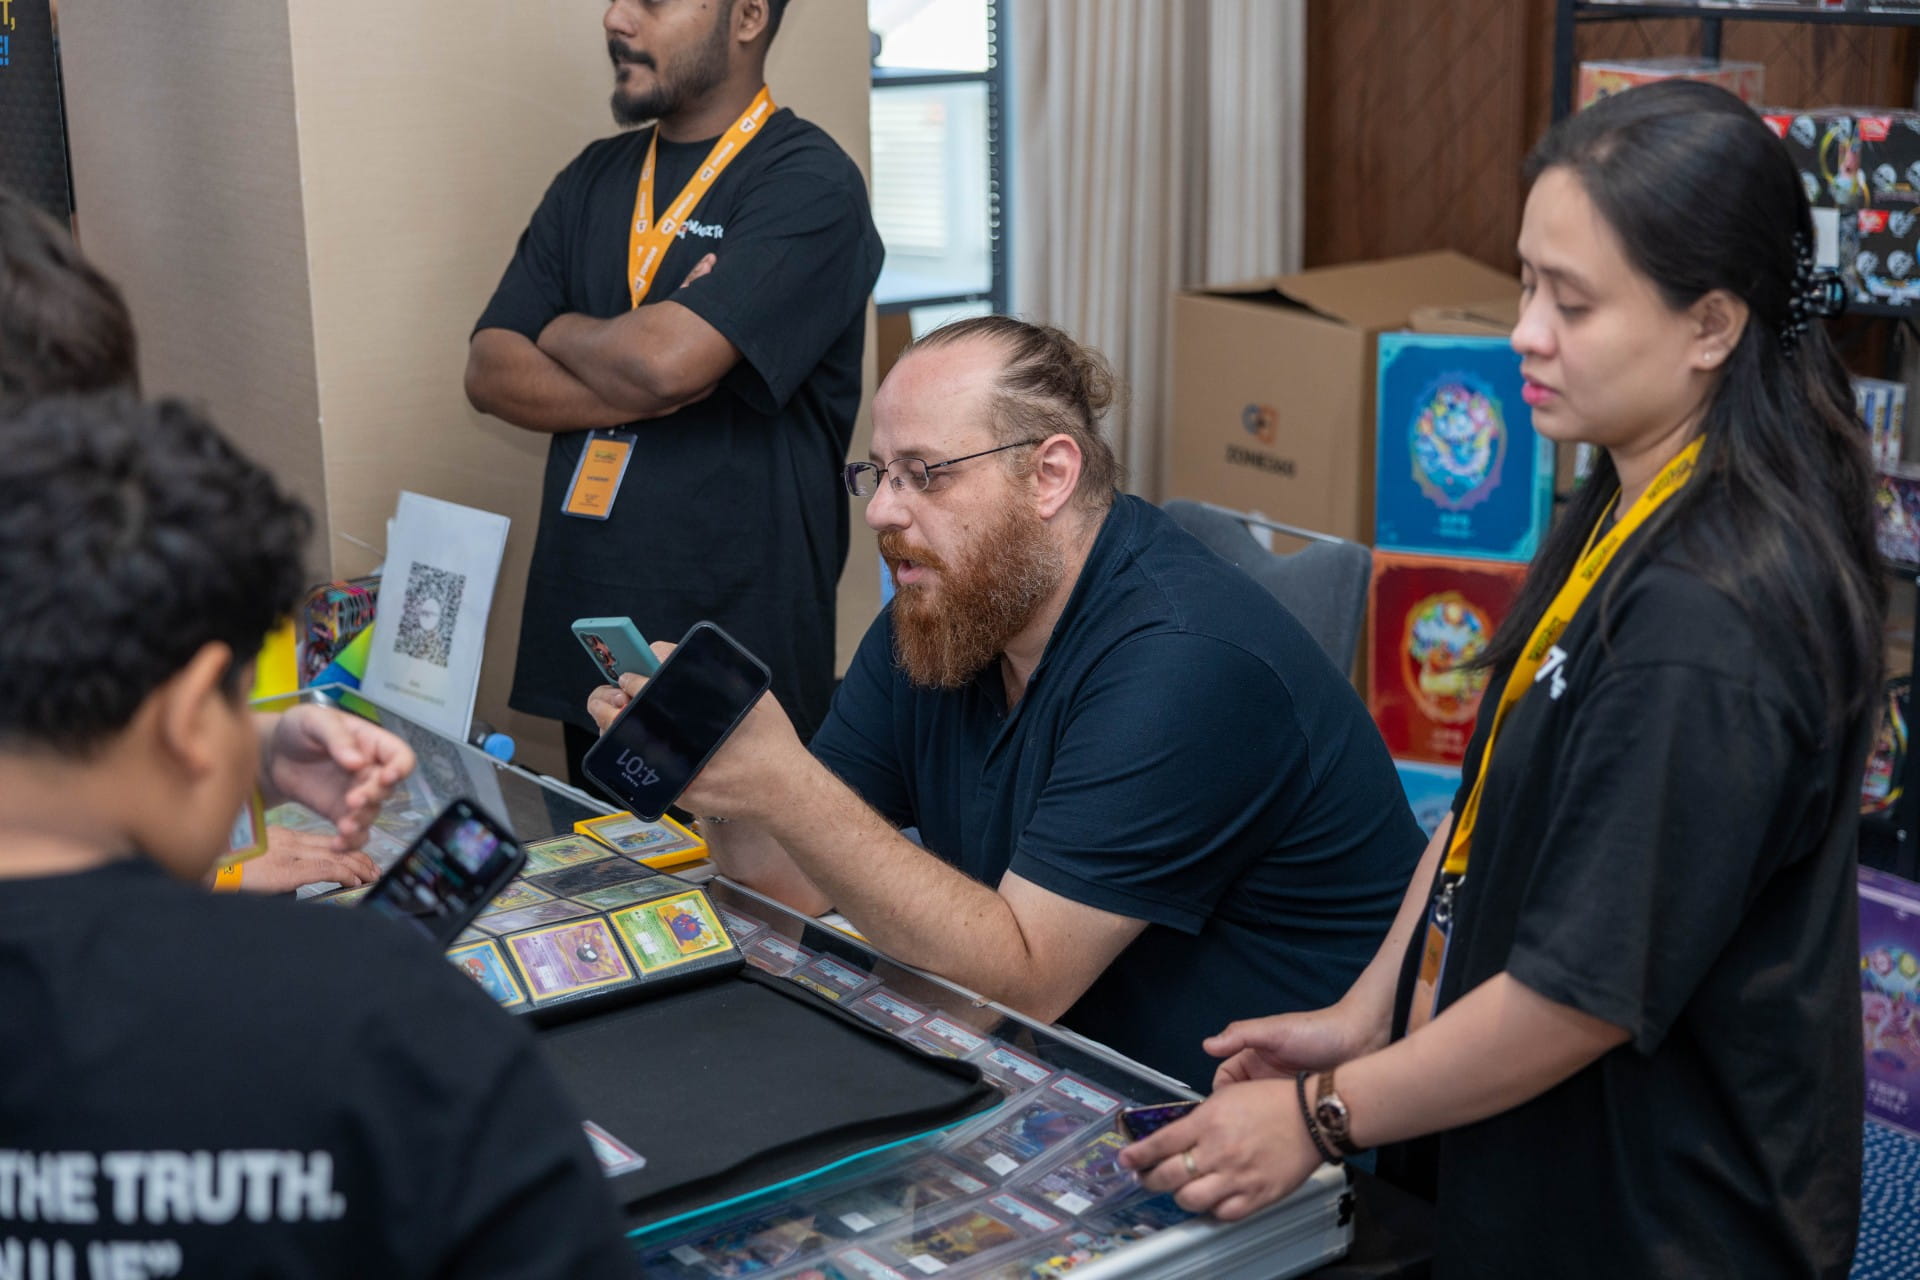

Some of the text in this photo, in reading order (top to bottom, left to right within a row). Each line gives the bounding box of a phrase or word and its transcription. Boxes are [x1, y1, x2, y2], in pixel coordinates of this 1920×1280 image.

[616, 748, 660, 785] 4:01
[0, 1150, 347, 1225] THE TRUTH.
